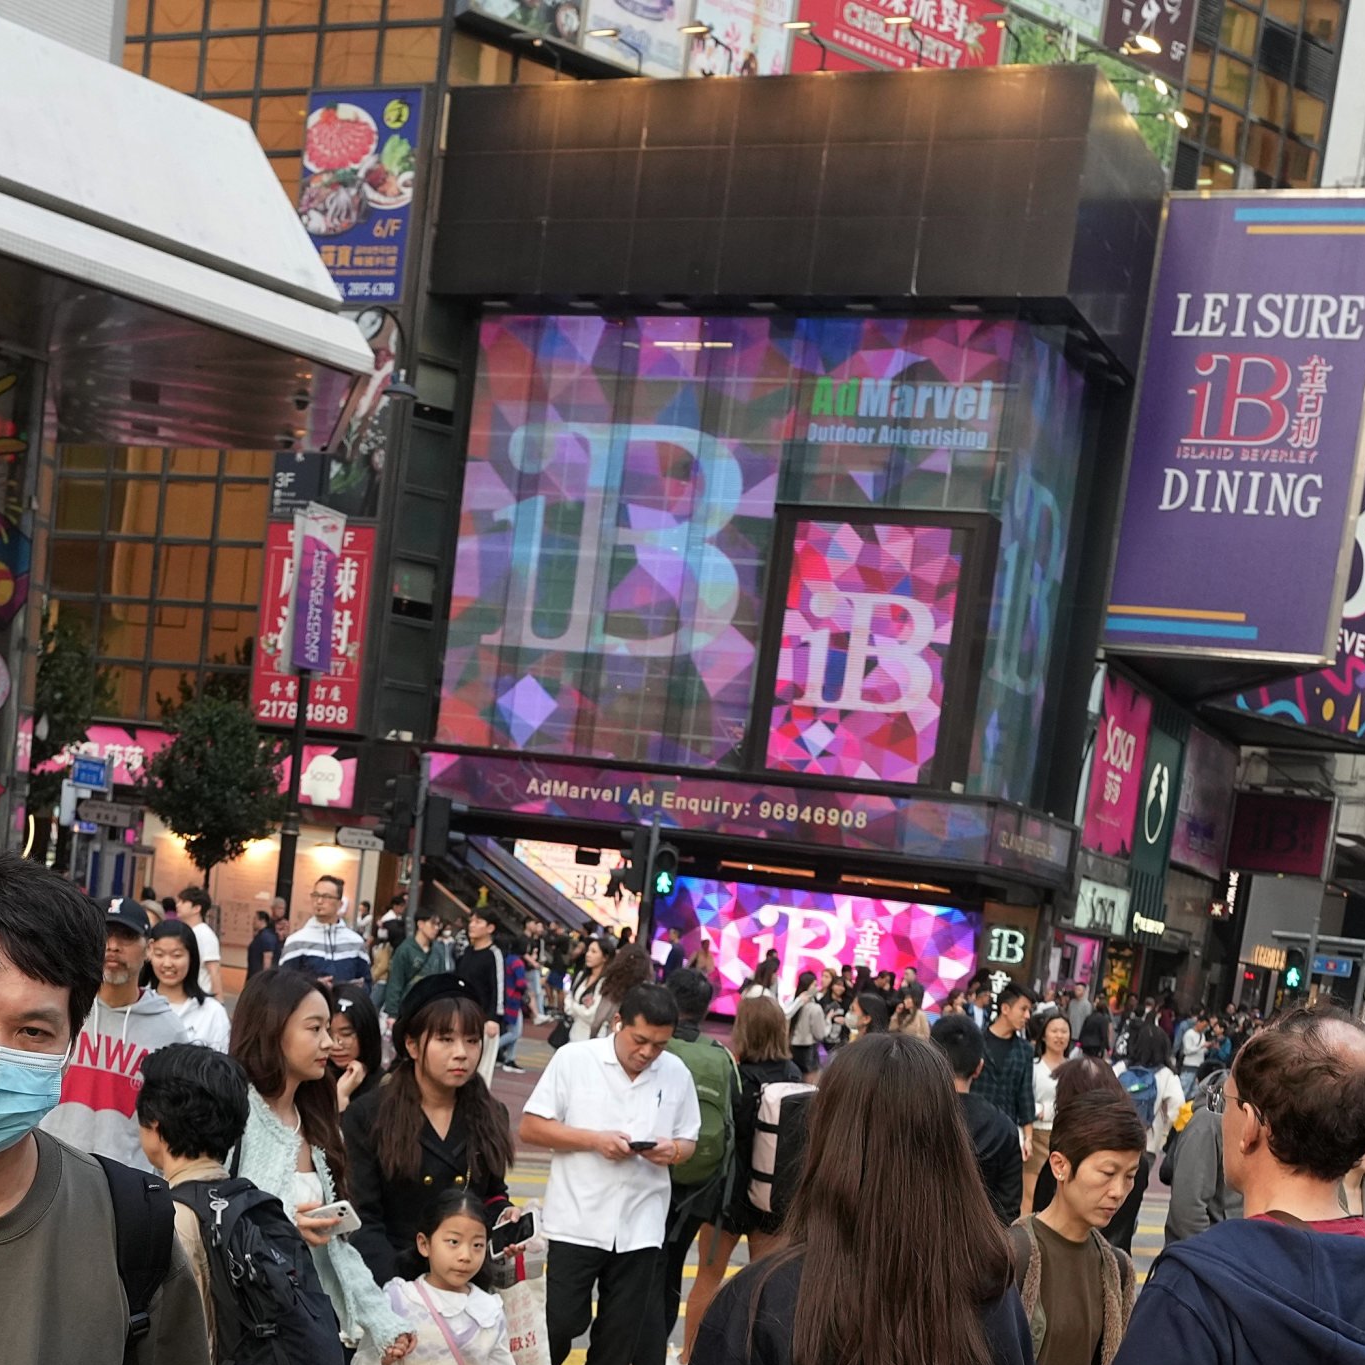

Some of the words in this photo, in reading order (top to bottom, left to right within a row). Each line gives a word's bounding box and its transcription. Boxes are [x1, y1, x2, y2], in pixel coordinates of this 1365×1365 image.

[1171, 292, 1365, 340] LEISURE
[811, 376, 994, 421] AdMarvel
[1288, 354, 1333, 448] 金百利
[807, 422, 873, 443] Outdoor
[1176, 446, 1234, 461] ISLAND
[1240, 447, 1318, 465] BEVERLEY
[1158, 468, 1323, 518] DINING
[259, 700, 297, 720] 2178
[526, 777, 620, 803] AdMarvel
[628, 788, 655, 806] Ad
[662, 791, 751, 818] Enquiry:
[759, 802, 868, 829] 96946908
[988, 928, 1025, 964] iB
